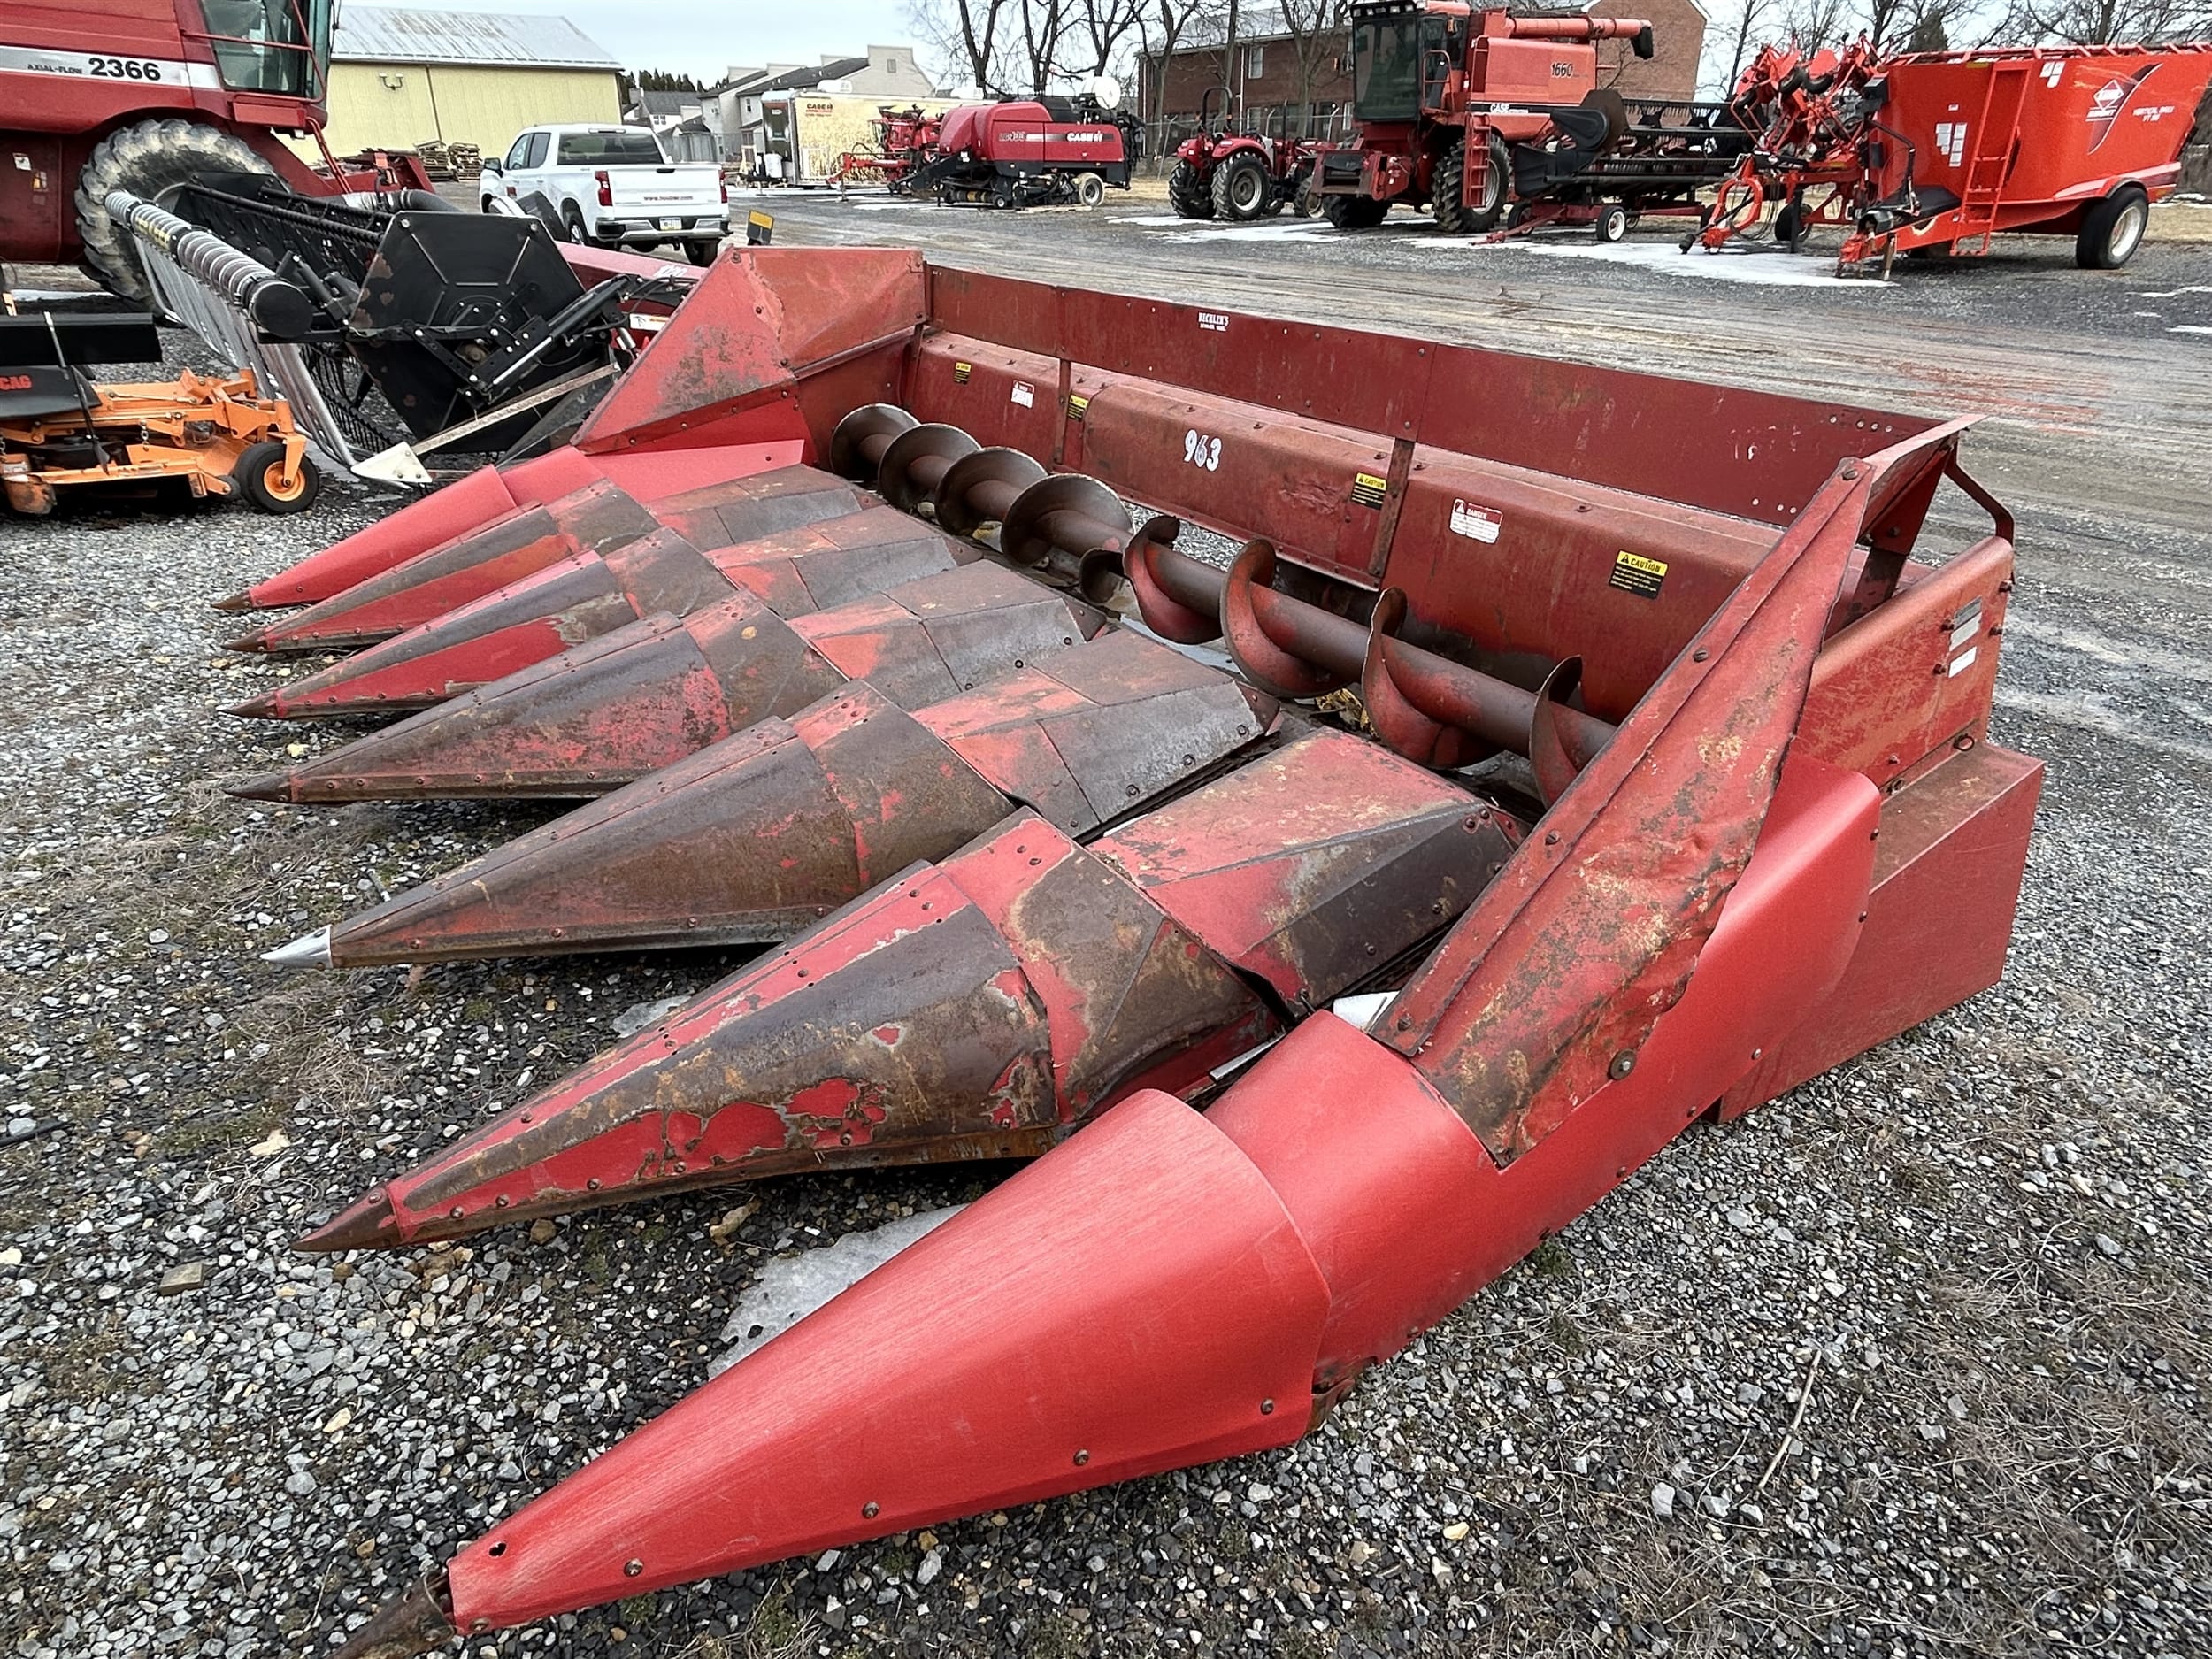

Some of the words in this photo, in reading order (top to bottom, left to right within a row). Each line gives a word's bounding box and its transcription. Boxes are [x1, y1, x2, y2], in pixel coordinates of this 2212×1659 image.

[27, 63, 83, 74] AXIAL-FLOW
[88, 57, 162, 81] 2366
[1550, 63, 1573, 77] 1660
[1067, 133, 1093, 142] CASE
[1184, 429, 1222, 472] 963
[1630, 558, 1661, 573] CAUTION
